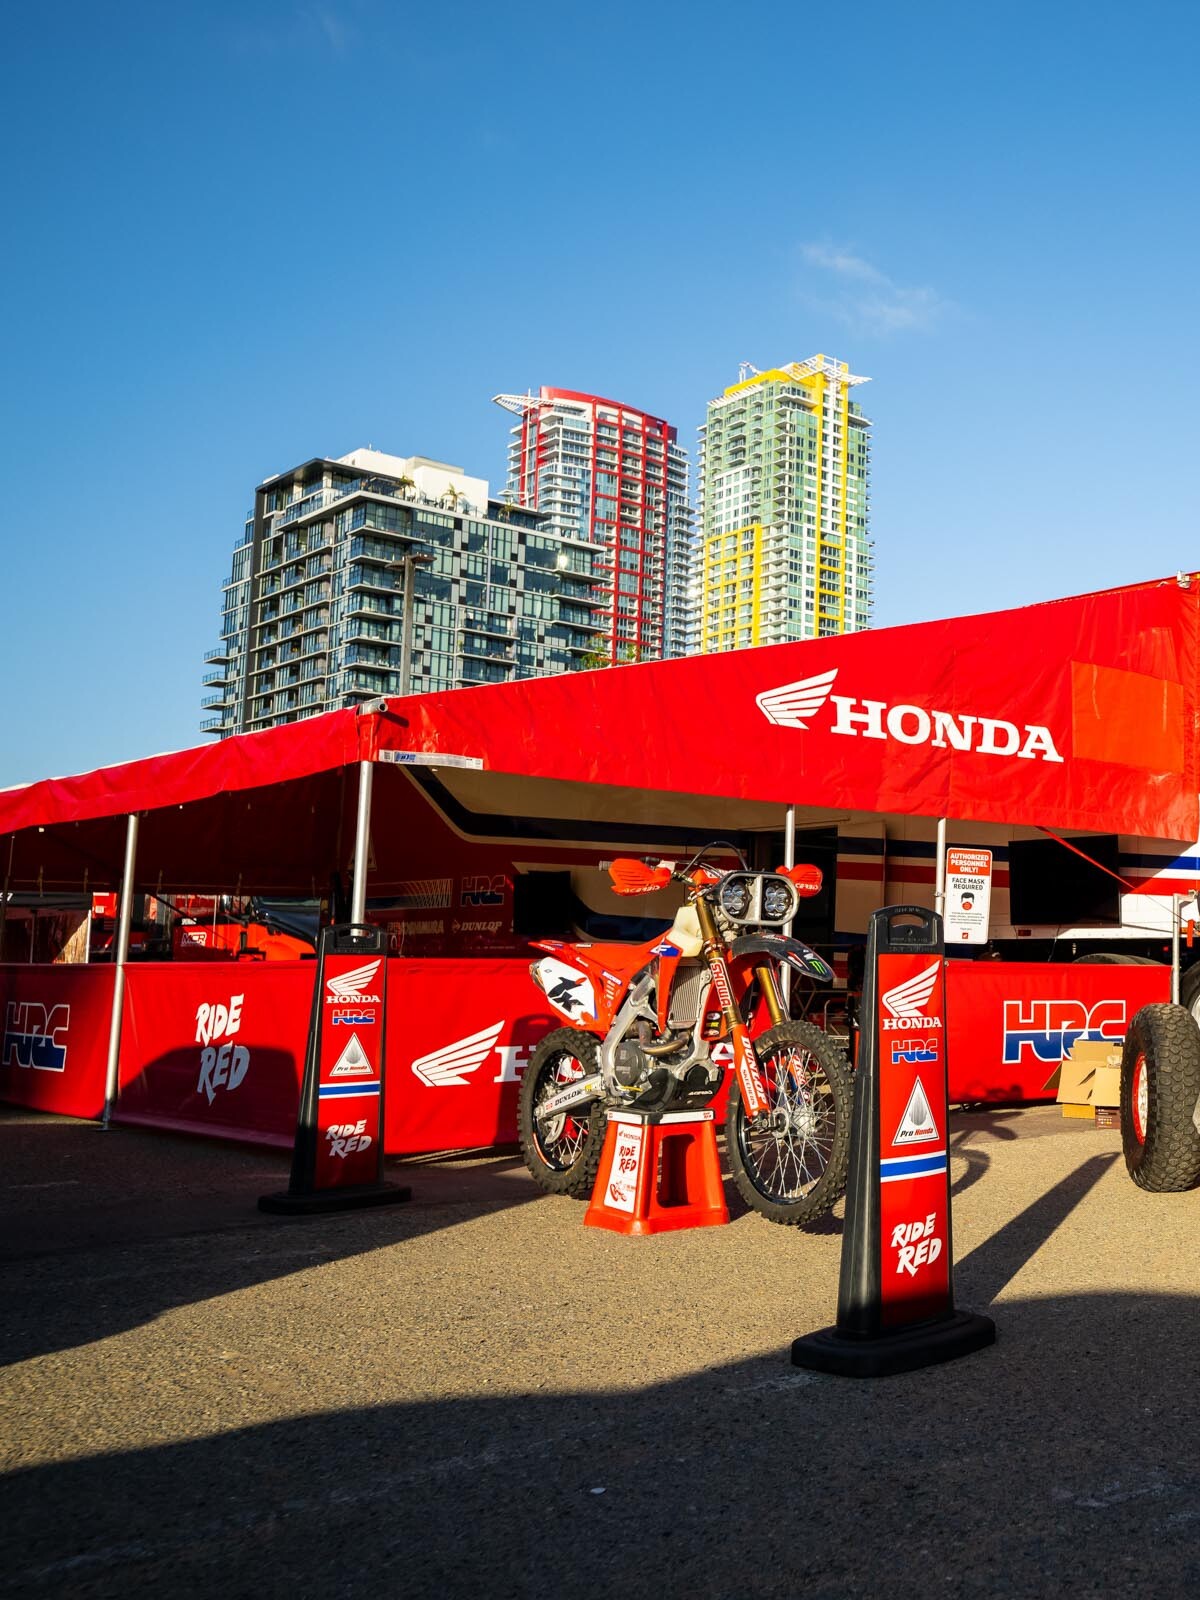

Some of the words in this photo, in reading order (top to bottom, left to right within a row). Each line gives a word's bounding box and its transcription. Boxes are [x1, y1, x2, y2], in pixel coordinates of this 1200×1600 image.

[829, 694, 1065, 763] HONDA
[950, 852, 990, 861] AUTHORIZED
[950, 859, 988, 868] PERSONNEL
[959, 866, 979, 874] ONLY!
[953, 883, 984, 891] REQUIRED
[461, 921, 503, 931] DUNLOP
[711, 962, 733, 1008] SHOWA
[326, 995, 381, 1004] HONDA
[195, 993, 245, 1046] RIDE
[332, 1009, 376, 1025] HRC
[882, 1016, 943, 1031] HONDA
[2, 1001, 71, 1073] HRC
[1002, 1000, 1127, 1064] HRC
[891, 1038, 939, 1065] HRC
[197, 1040, 250, 1105] RED
[741, 1036, 769, 1105] DUNLOP
[326, 1119, 367, 1141] RIDE
[623, 1132, 641, 1140] HONDA
[899, 1129, 913, 1138] Pro
[914, 1127, 934, 1136] Honda
[329, 1134, 373, 1160] RED
[618, 1145, 637, 1157] RIDE
[618, 1157, 638, 1174] RED
[890, 1212, 937, 1248] RIDE
[895, 1237, 943, 1277] RED
